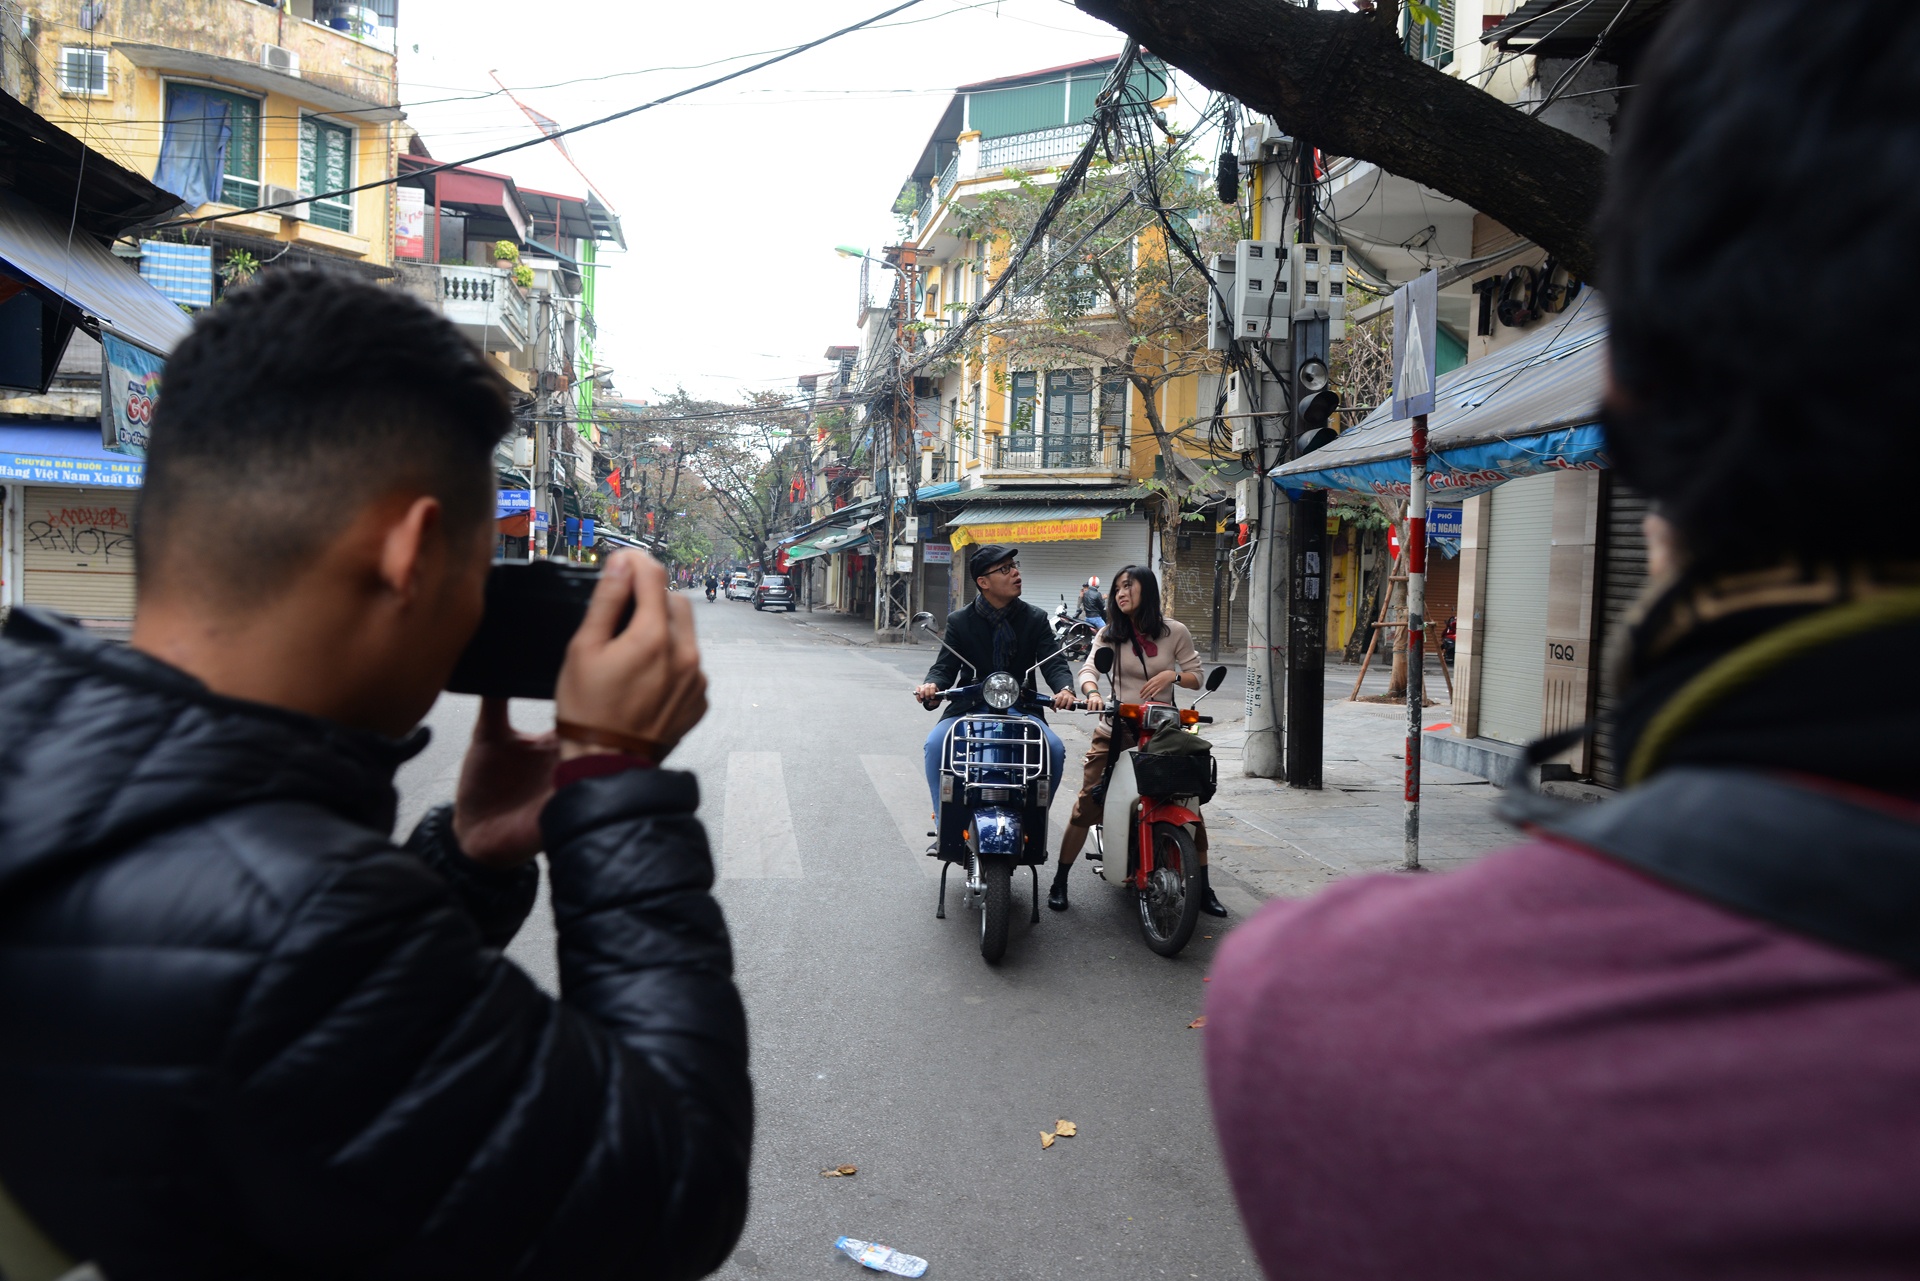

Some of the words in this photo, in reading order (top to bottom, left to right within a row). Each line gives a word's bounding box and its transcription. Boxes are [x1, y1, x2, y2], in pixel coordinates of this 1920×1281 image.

[0, 465, 30, 479] Hàng
[34, 468, 59, 481] Việt
[62, 470, 90, 481] Nam
[93, 472, 123, 484] Xuất
[15, 458, 53, 467] CHUYÊN
[55, 460, 73, 469] BÁN
[76, 462, 102, 471] BUÔN
[111, 464, 130, 473] BÁN
[1549, 643, 1574, 661] TQQ
